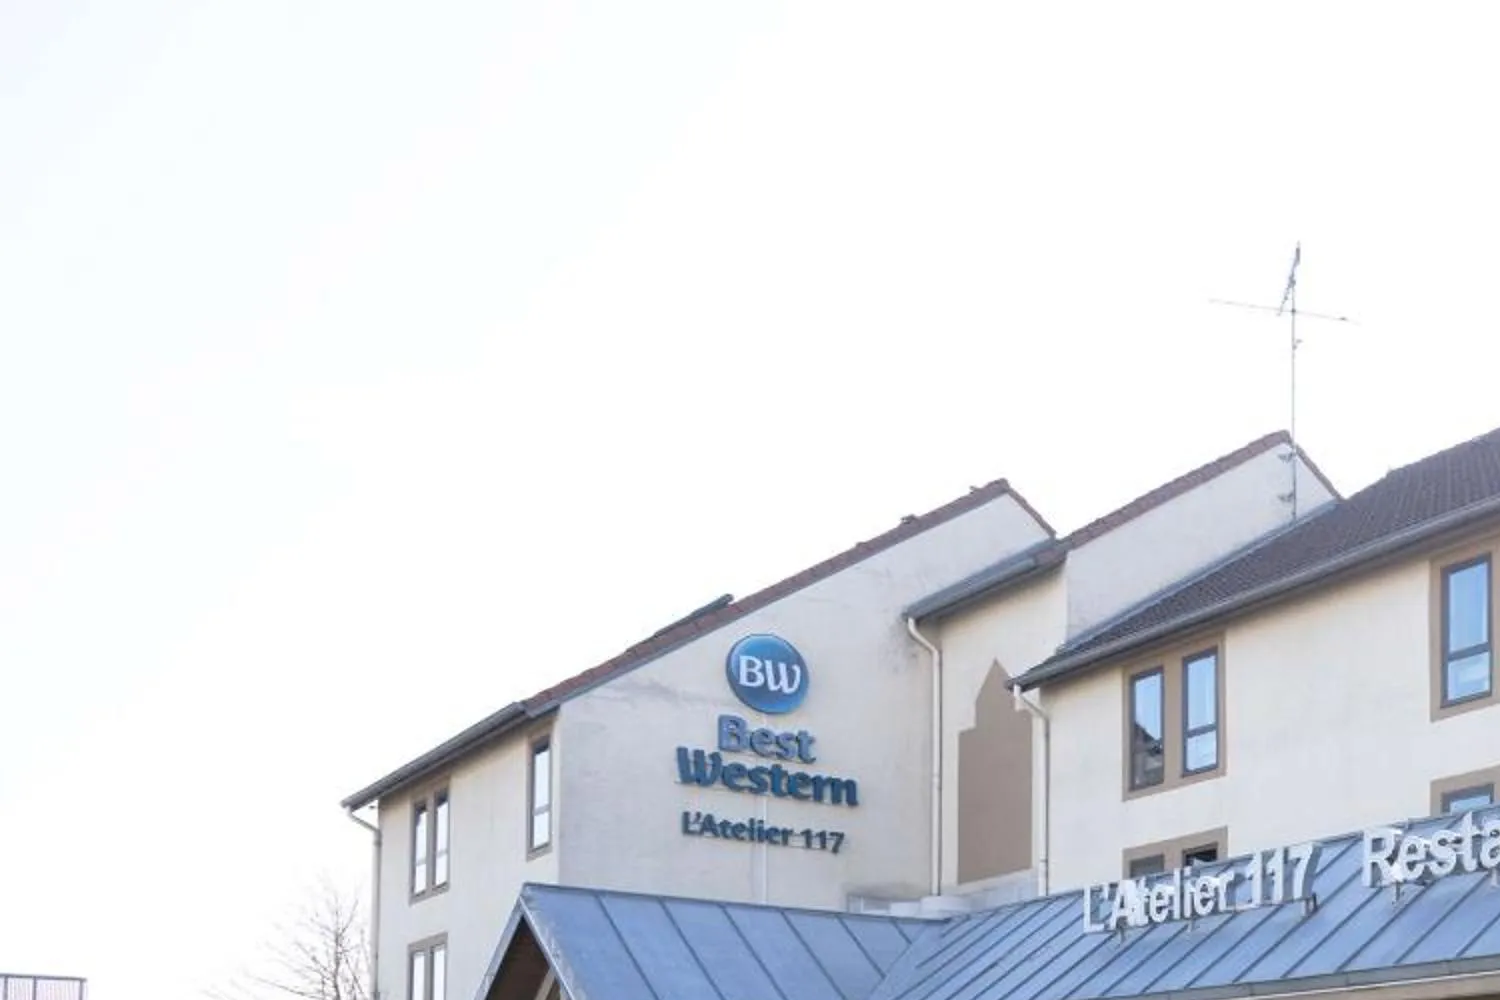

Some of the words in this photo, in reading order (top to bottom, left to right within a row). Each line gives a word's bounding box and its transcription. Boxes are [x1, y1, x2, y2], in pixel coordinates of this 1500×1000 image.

[738, 655, 801, 694] BW
[718, 714, 817, 765] Best
[675, 746, 860, 807] Western
[682, 810, 795, 846] L'Atelier
[797, 829, 846, 855] 117
[1083, 866, 1235, 933] L'Atelier
[1246, 841, 1319, 908] 117
